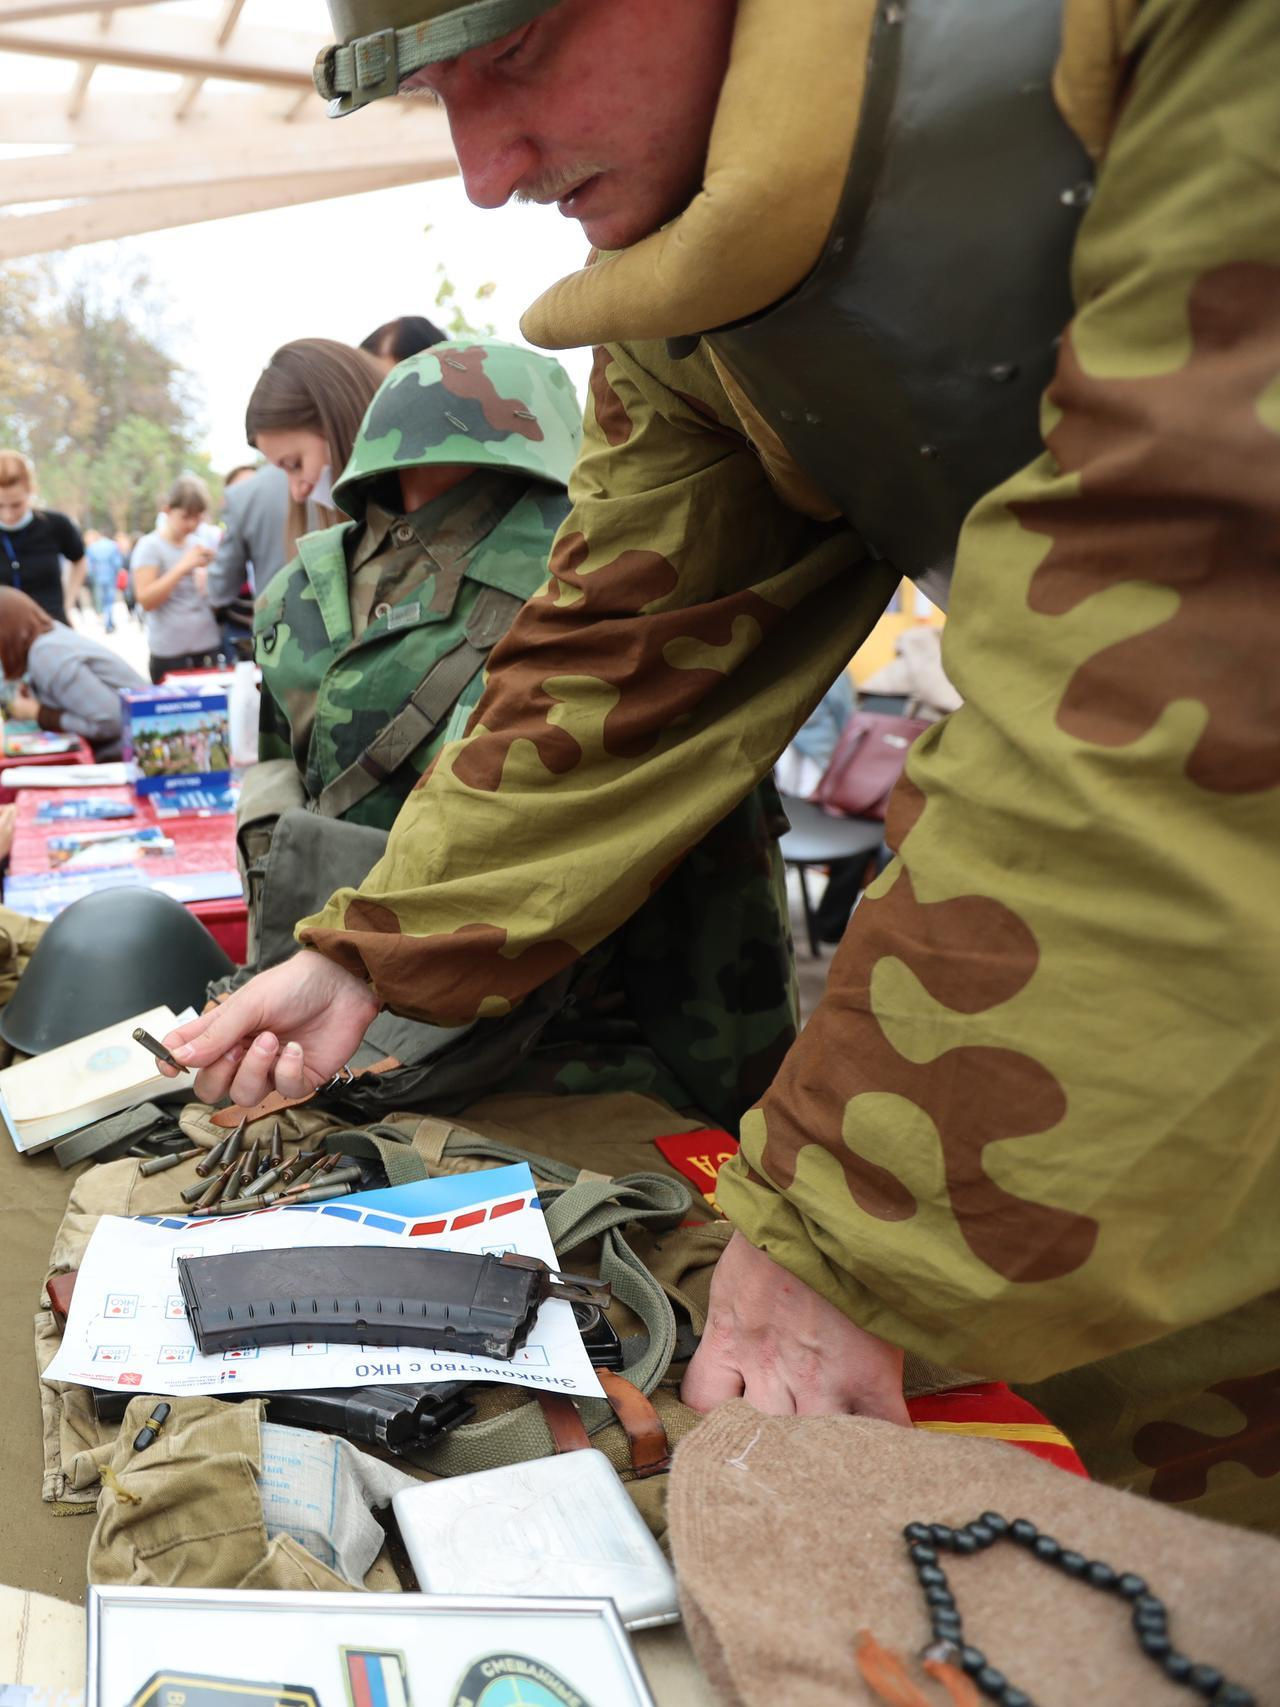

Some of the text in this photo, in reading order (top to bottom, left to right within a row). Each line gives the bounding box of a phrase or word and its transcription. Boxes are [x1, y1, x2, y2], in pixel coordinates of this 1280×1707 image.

[355, 1362, 577, 1389] Знакомство с НКО
